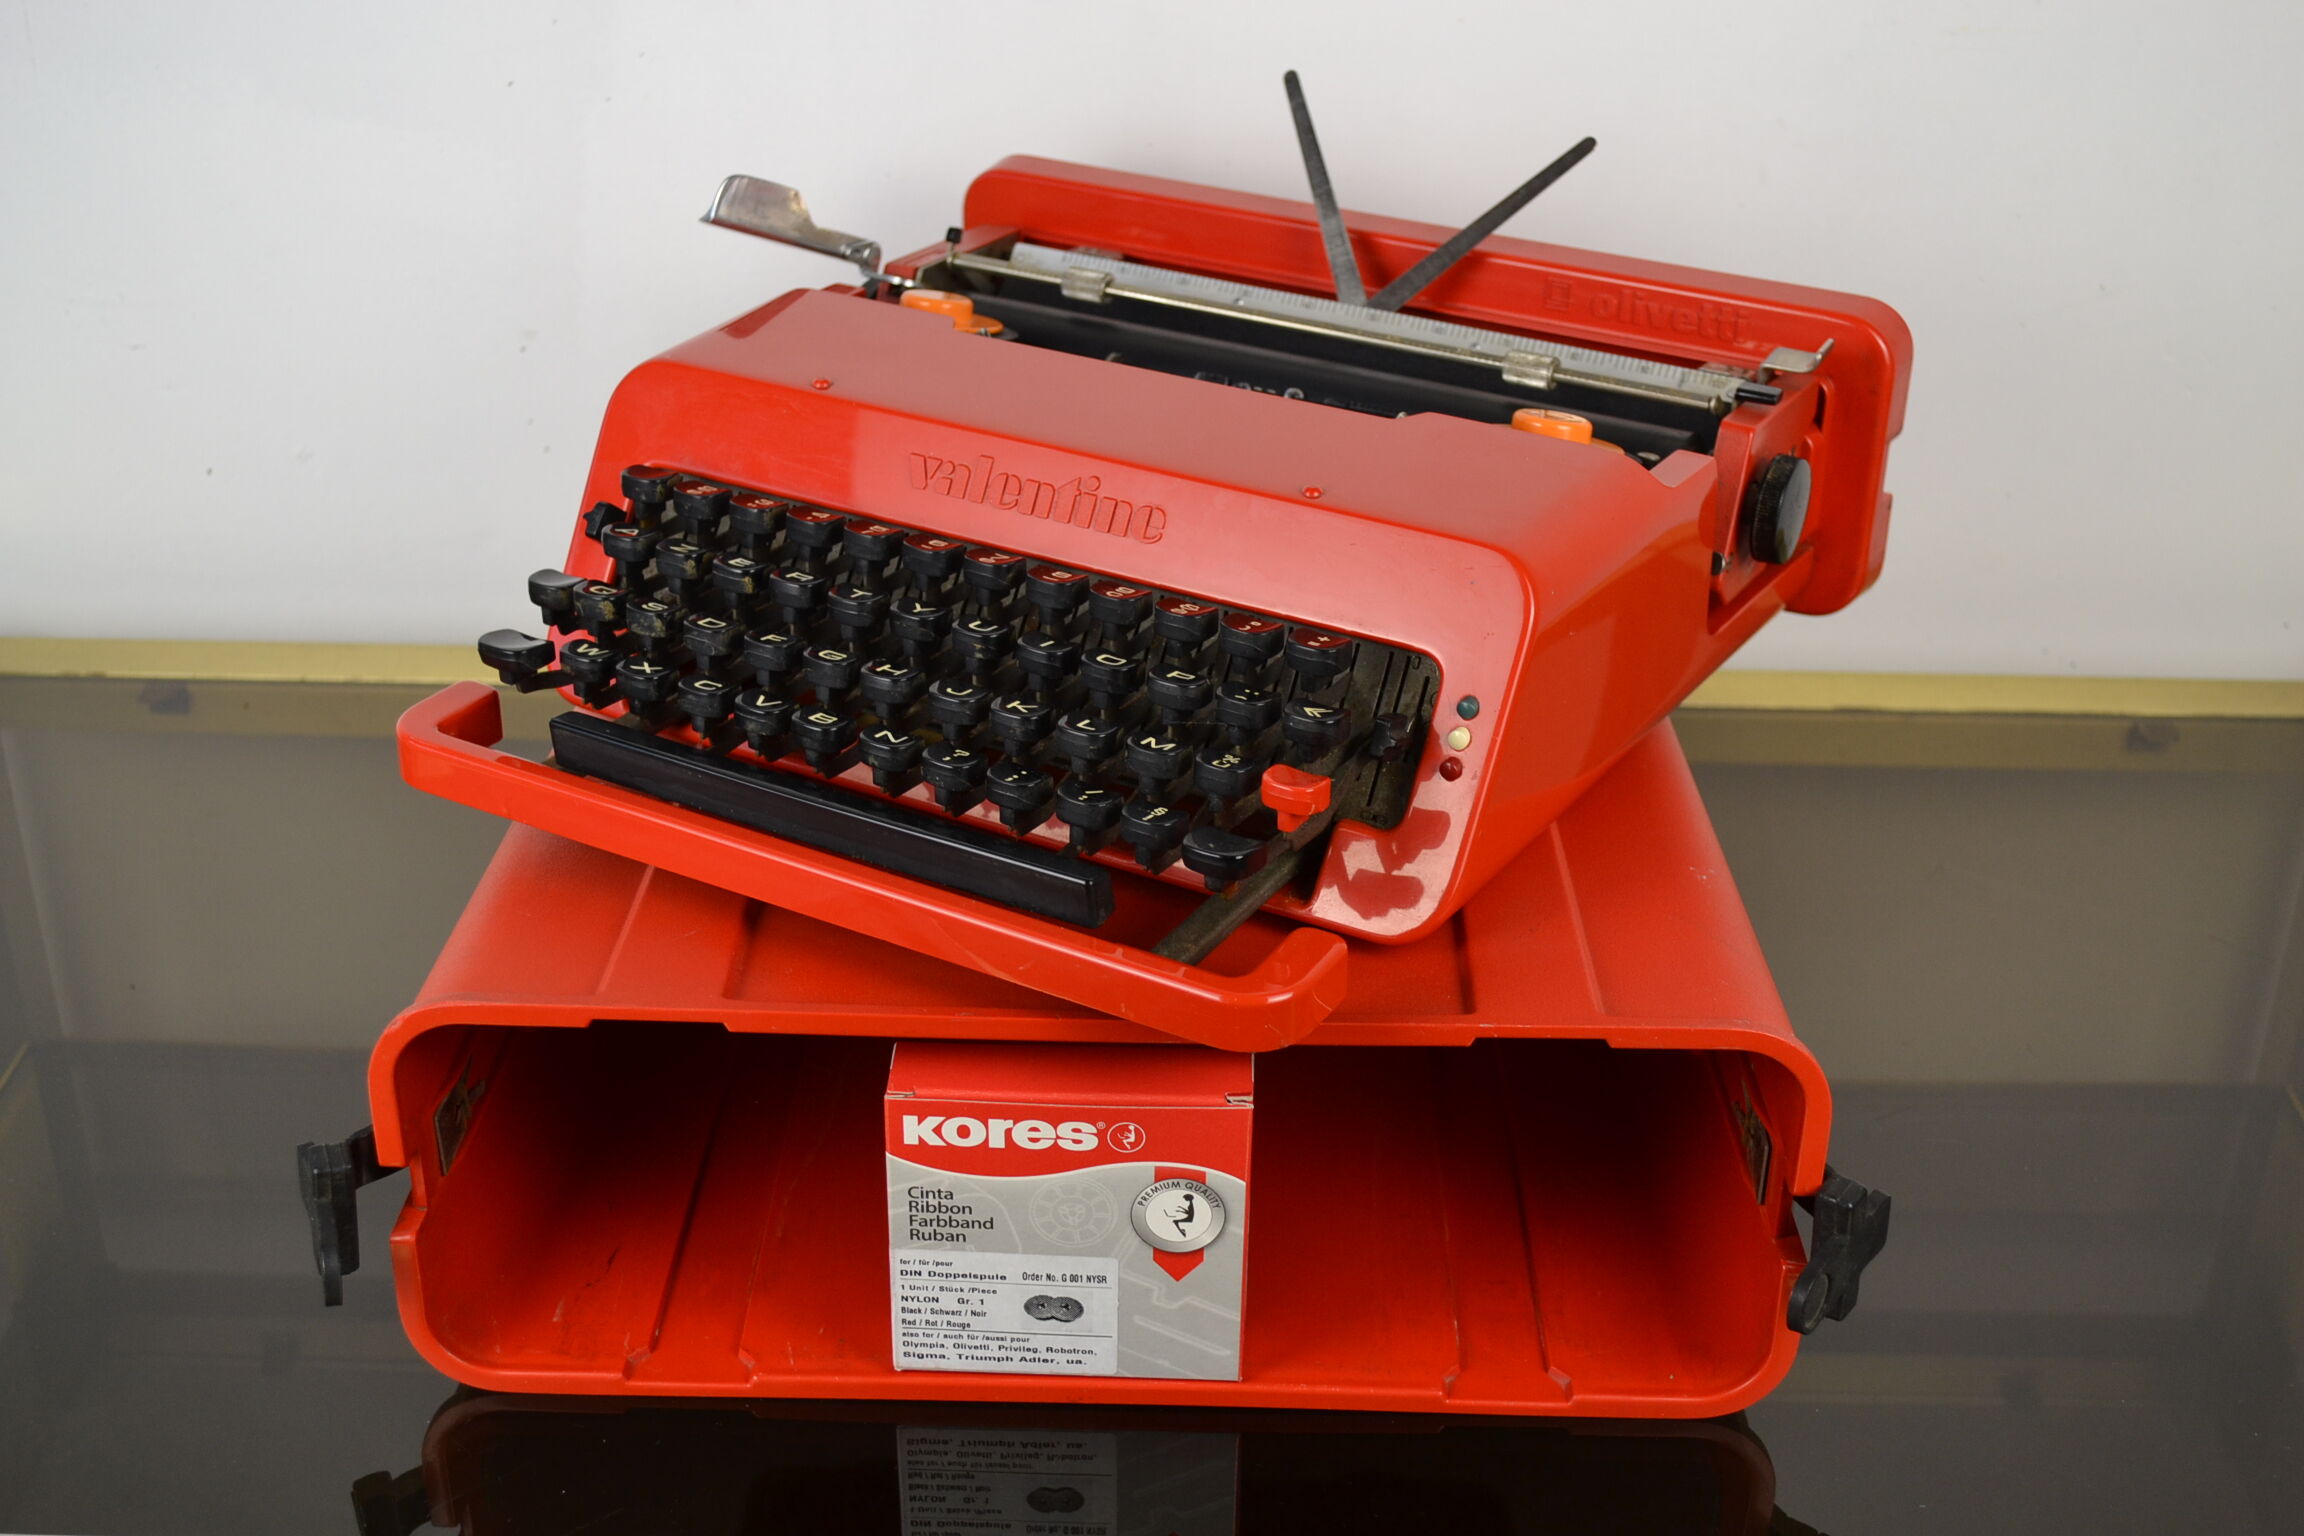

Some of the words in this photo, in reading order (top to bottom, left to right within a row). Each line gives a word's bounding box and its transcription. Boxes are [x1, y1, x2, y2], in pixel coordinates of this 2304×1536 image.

[1590, 290, 1748, 343] olivetti
[909, 452, 1167, 544] valentine
[728, 557, 755, 567] E
[785, 571, 814, 582] R
[850, 588, 873, 598] T
[912, 602, 937, 613] Y
[968, 620, 998, 631] U
[1166, 671, 1195, 680] P
[641, 602, 668, 612] S
[697, 617, 727, 629] D
[760, 634, 788, 643] F
[818, 650, 847, 661] G
[875, 664, 908, 676] H
[946, 687, 973, 696] J
[1005, 700, 1039, 713] K
[1076, 719, 1096, 731] L
[1140, 736, 1177, 751] M
[576, 643, 609, 656] W
[629, 661, 664, 674] X
[694, 679, 723, 691] C
[755, 695, 783, 707] V
[808, 712, 838, 724] B
[874, 730, 909, 744] N
[902, 1115, 1099, 1152] Kores
[908, 1186, 954, 1200] Cinta
[1137, 1181, 1181, 1207] PREMIUM
[1185, 1181, 1221, 1209] QUALITY
[908, 1201, 973, 1215] Ribbon
[909, 1214, 994, 1230] Farbband
[909, 1228, 967, 1243] Ruban
[900, 1269, 922, 1277] DIN
[928, 1270, 1007, 1281] Doppelspule
[1022, 1272, 1043, 1281] Order
[1046, 1273, 1059, 1282] No.
[1061, 1274, 1067, 1282] G
[1070, 1274, 1083, 1283] 001
[1086, 1275, 1107, 1284] NYSR
[909, 1284, 929, 1292] Unit
[939, 1285, 965, 1293] Stück
[901, 1295, 940, 1303] NYLON
[957, 1297, 974, 1305] Gr.
[901, 1306, 922, 1314] Black
[930, 1307, 962, 1316] Schwarz
[970, 1310, 987, 1318] Noir
[901, 1318, 916, 1326] Red
[925, 1319, 938, 1327] Rot
[946, 1320, 971, 1330] Rouge
[956, 1353, 1013, 1363] Triumph
